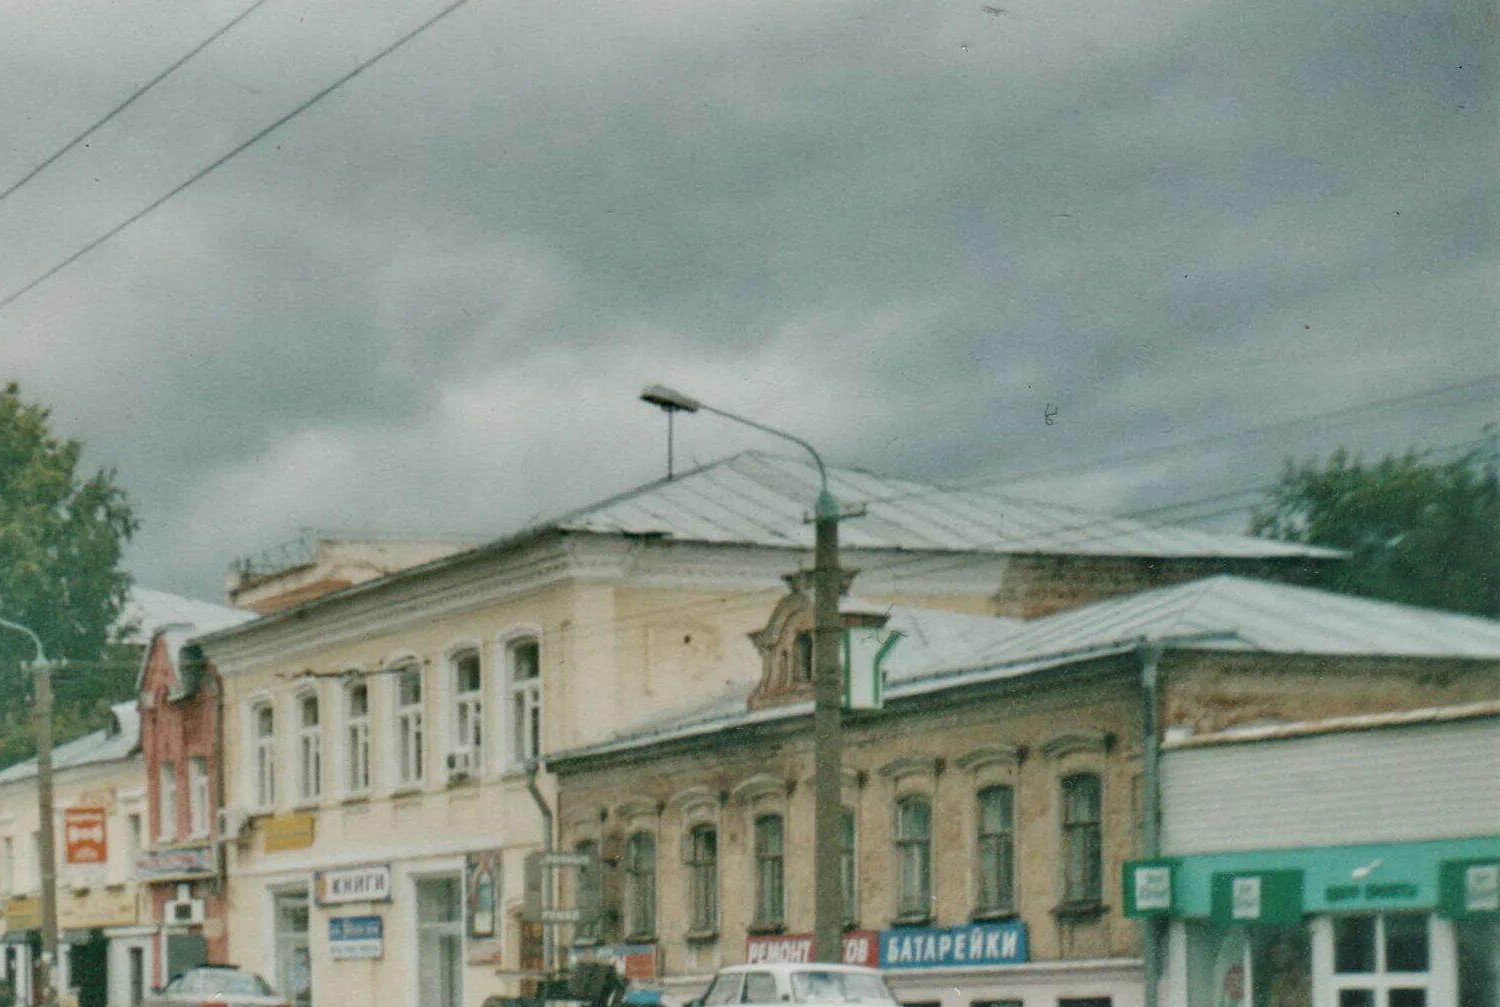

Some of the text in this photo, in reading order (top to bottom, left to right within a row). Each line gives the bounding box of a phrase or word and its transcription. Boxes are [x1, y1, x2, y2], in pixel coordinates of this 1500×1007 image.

[331, 873, 386, 896] КНИГИ
[748, 938, 812, 965] РЕМОНТ
[886, 927, 1019, 964] БАТАРЕЙКИ
